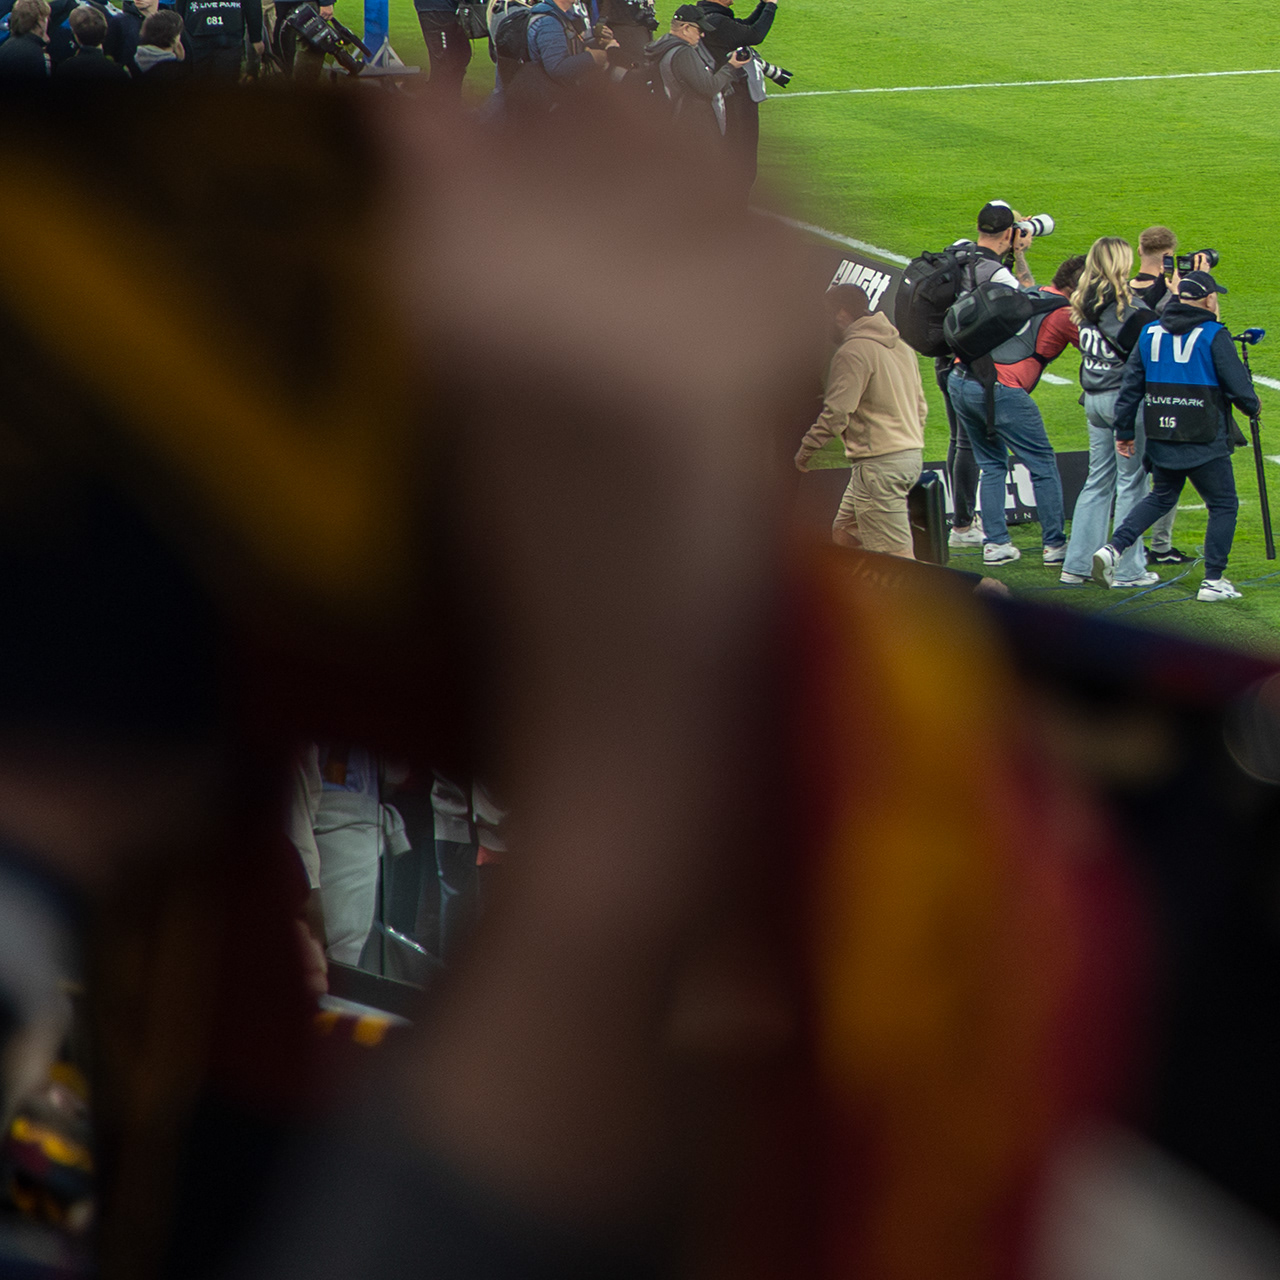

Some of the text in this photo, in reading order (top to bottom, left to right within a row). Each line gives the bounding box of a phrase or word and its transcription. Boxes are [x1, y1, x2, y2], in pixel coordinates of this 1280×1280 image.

[200, 1, 243, 10] LIVE PARK
[1148, 325, 1203, 364] TV
[1151, 396, 1205, 408] LIVE PARK
